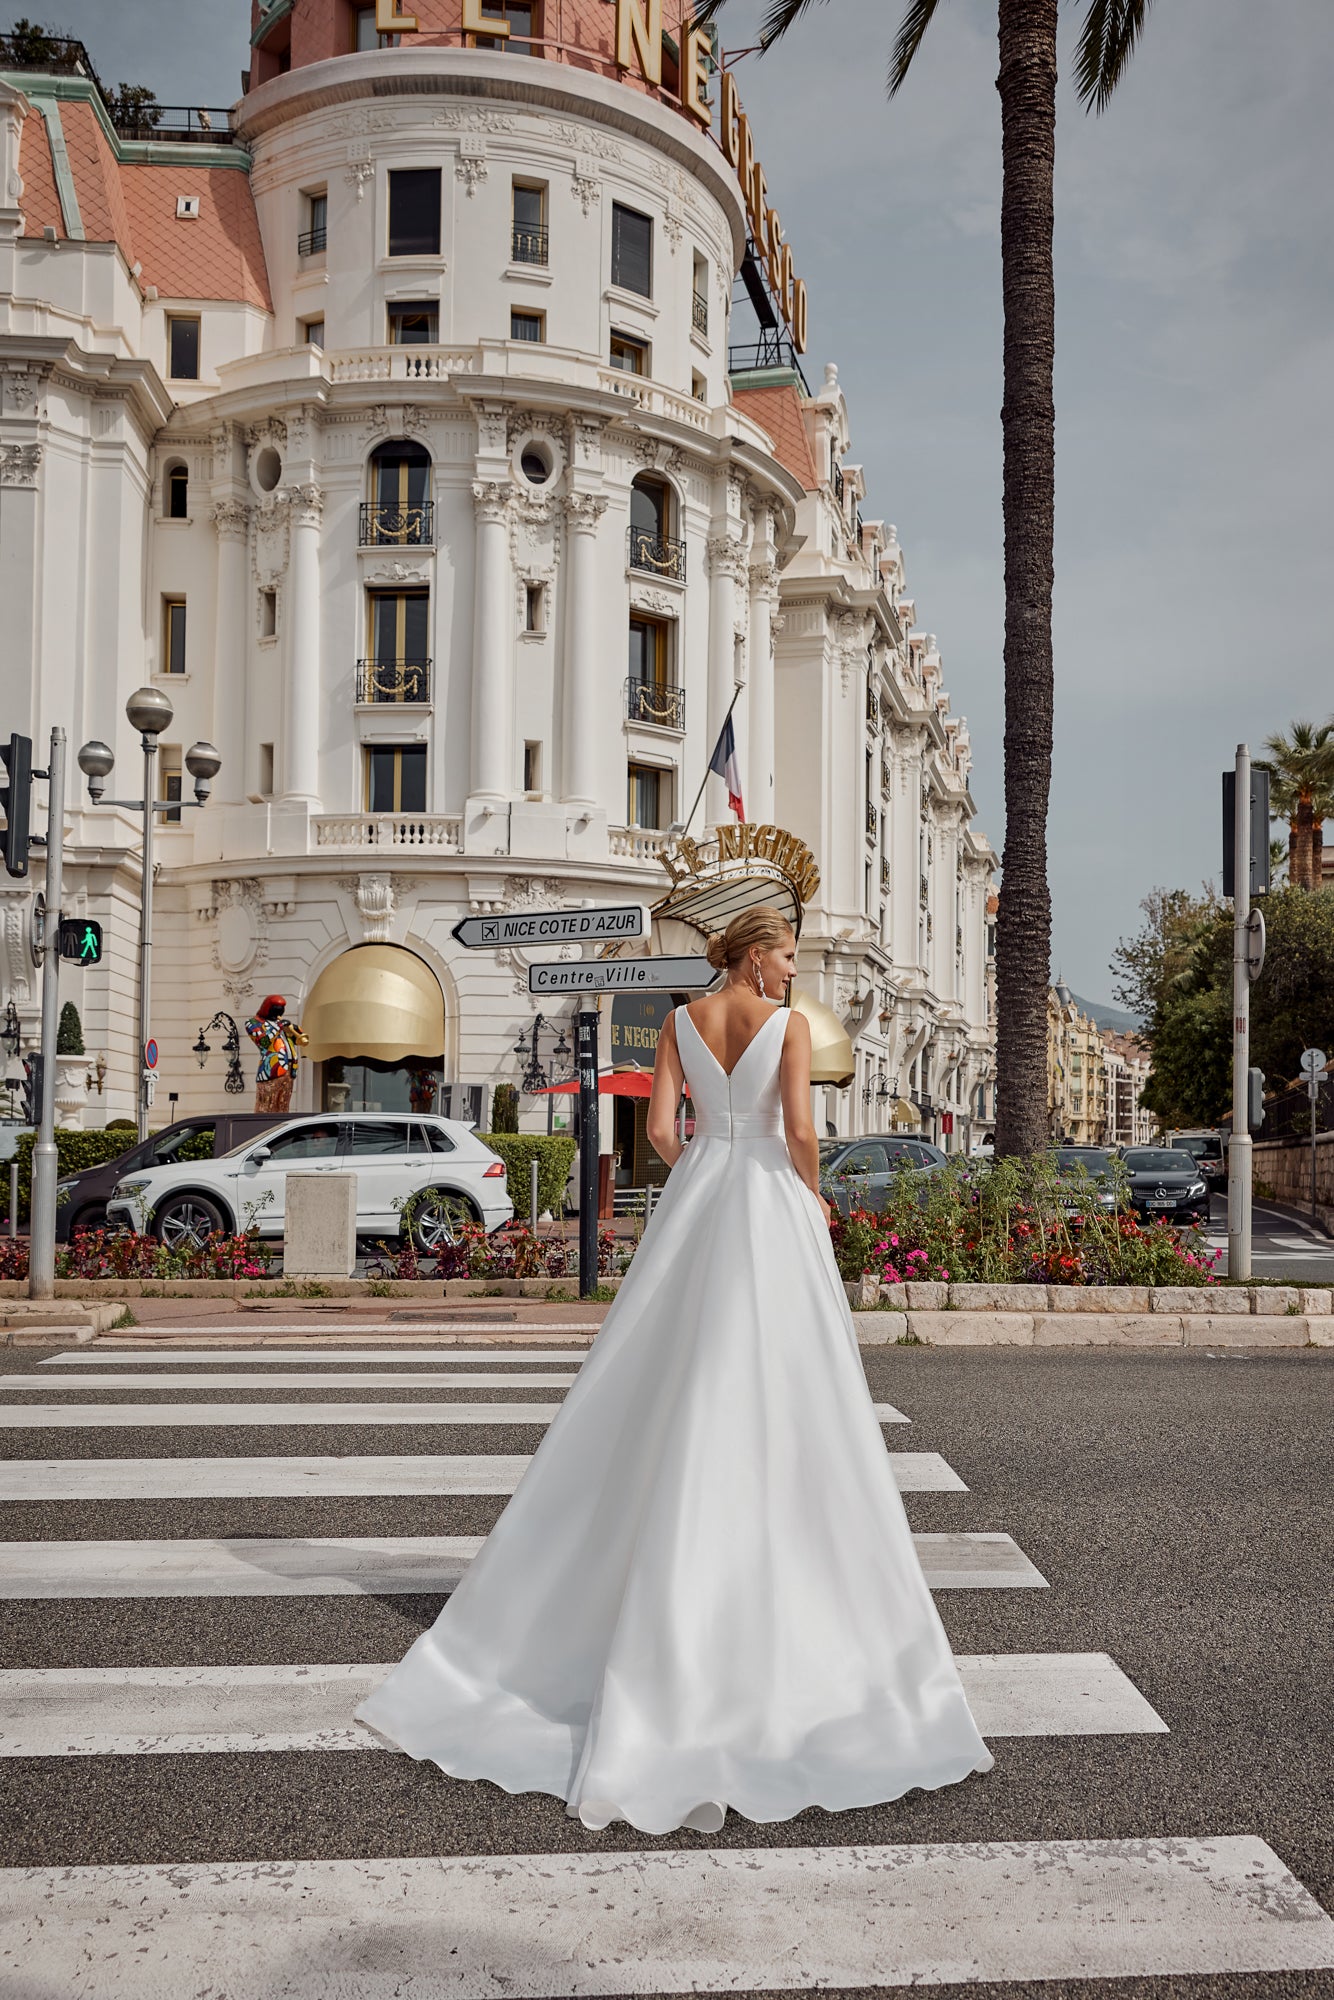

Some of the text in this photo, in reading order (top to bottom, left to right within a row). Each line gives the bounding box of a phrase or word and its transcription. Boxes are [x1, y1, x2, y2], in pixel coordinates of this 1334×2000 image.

[655, 837, 706, 885] LE
[504, 921, 536, 937] NICE
[539, 918, 577, 934] COTE
[537, 966, 646, 985] Centre Ville
[611, 1024, 620, 1046] E
[624, 1025, 661, 1049] NEGR
